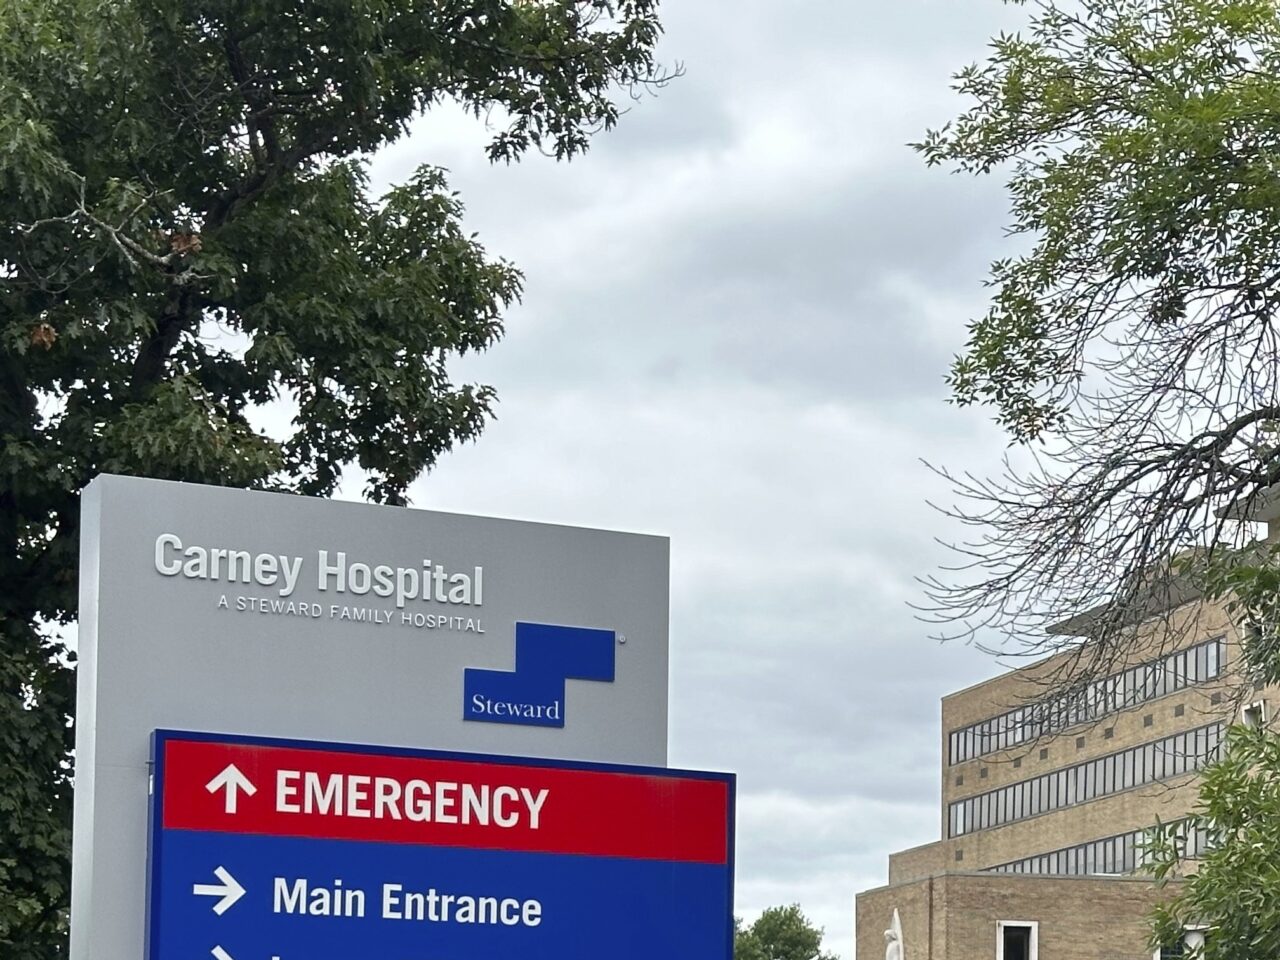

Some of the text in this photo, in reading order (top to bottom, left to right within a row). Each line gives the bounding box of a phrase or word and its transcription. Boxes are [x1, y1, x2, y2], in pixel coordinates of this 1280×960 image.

[154, 532, 484, 609] Carney Hospital
[217, 594, 486, 634] A STEWARD FAMILY HOSPITAL
[471, 693, 561, 720] Steward
[275, 769, 550, 830] EMERGENCY
[273, 877, 543, 928] Main Entrance
